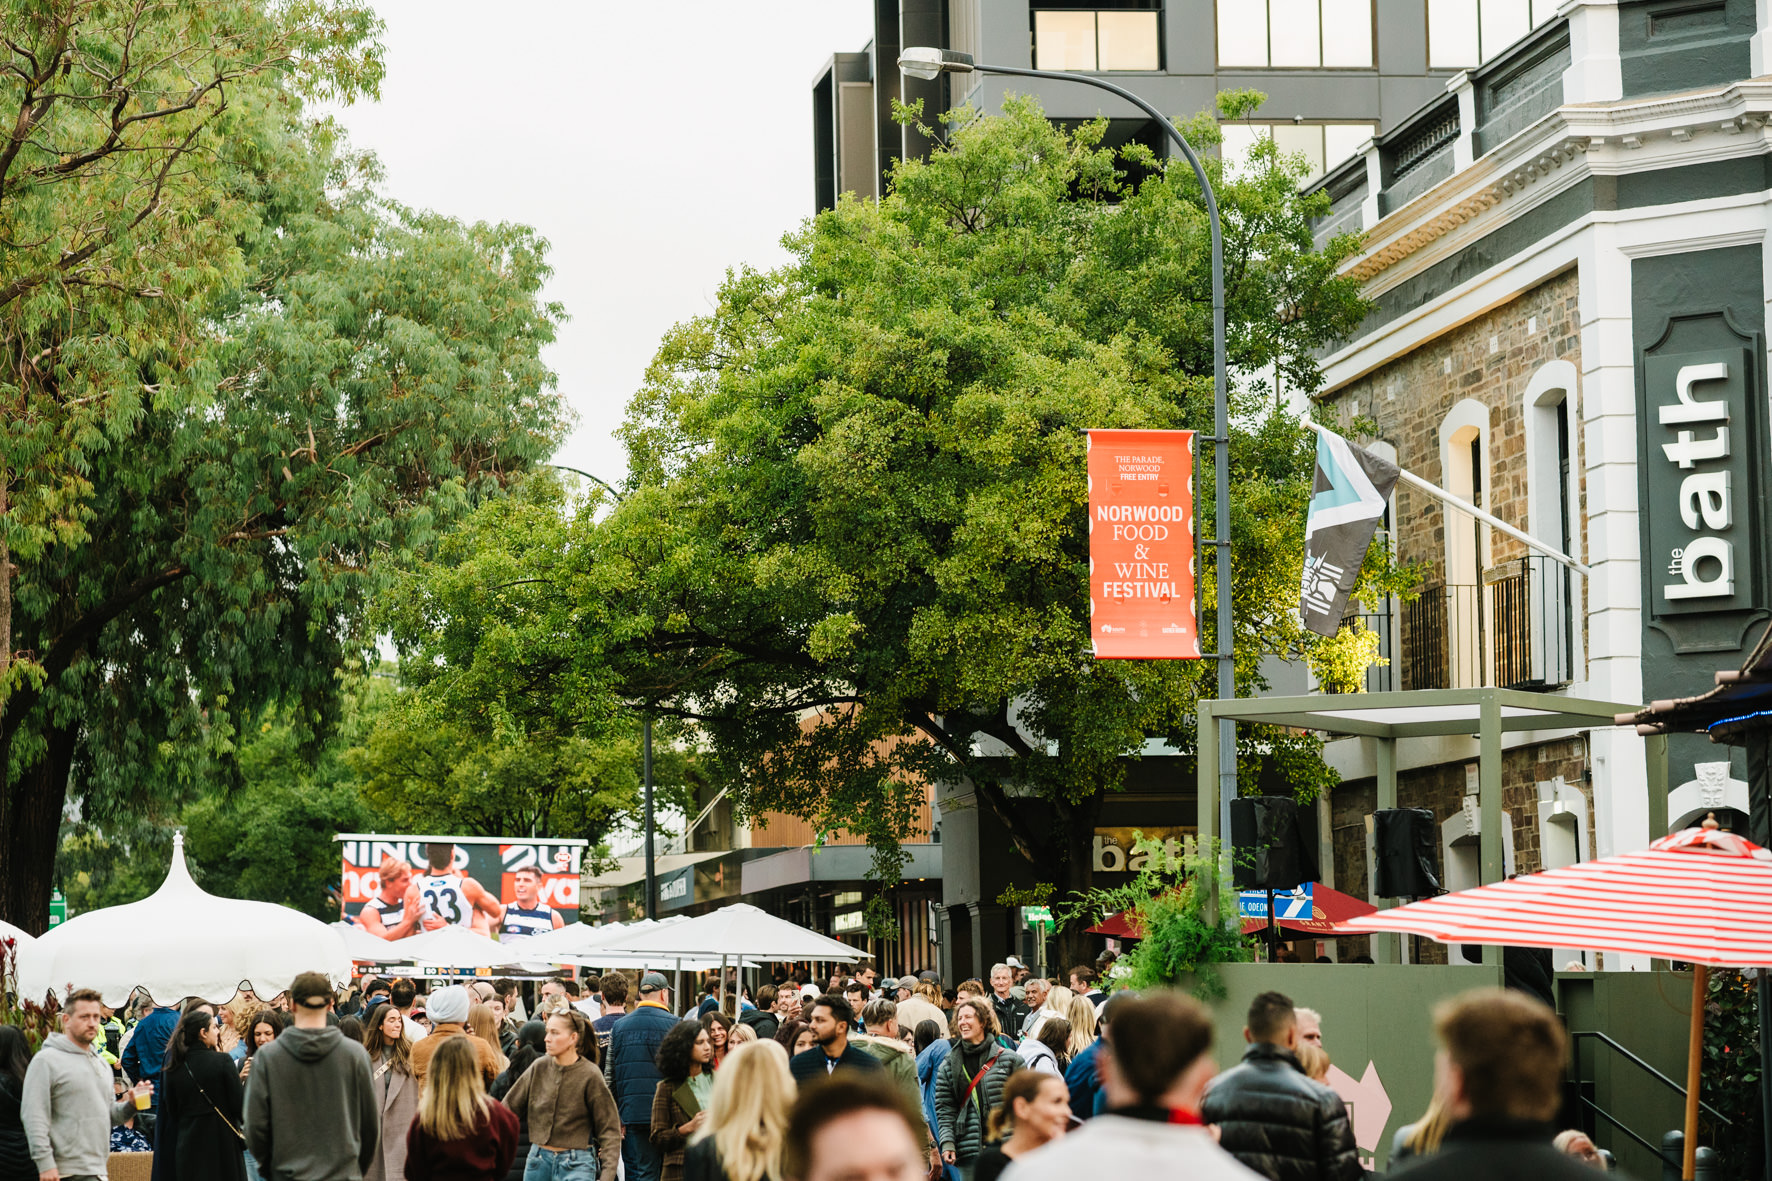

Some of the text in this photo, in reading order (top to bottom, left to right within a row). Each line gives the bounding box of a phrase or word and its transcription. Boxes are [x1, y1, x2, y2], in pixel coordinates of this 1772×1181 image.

[1114, 455, 1165, 465] THE PARADE,
[1118, 464, 1161, 473] NORWOOD
[1120, 473, 1159, 481] FREE ENTRY
[1658, 362, 1735, 600] the bath
[1097, 505, 1183, 522] NORWOOD
[1112, 524, 1168, 541] FOOD
[1134, 543, 1150, 560] &
[1114, 562, 1170, 579] WINE
[1103, 581, 1181, 599] FESTIVAL
[1104, 835, 1118, 845] the
